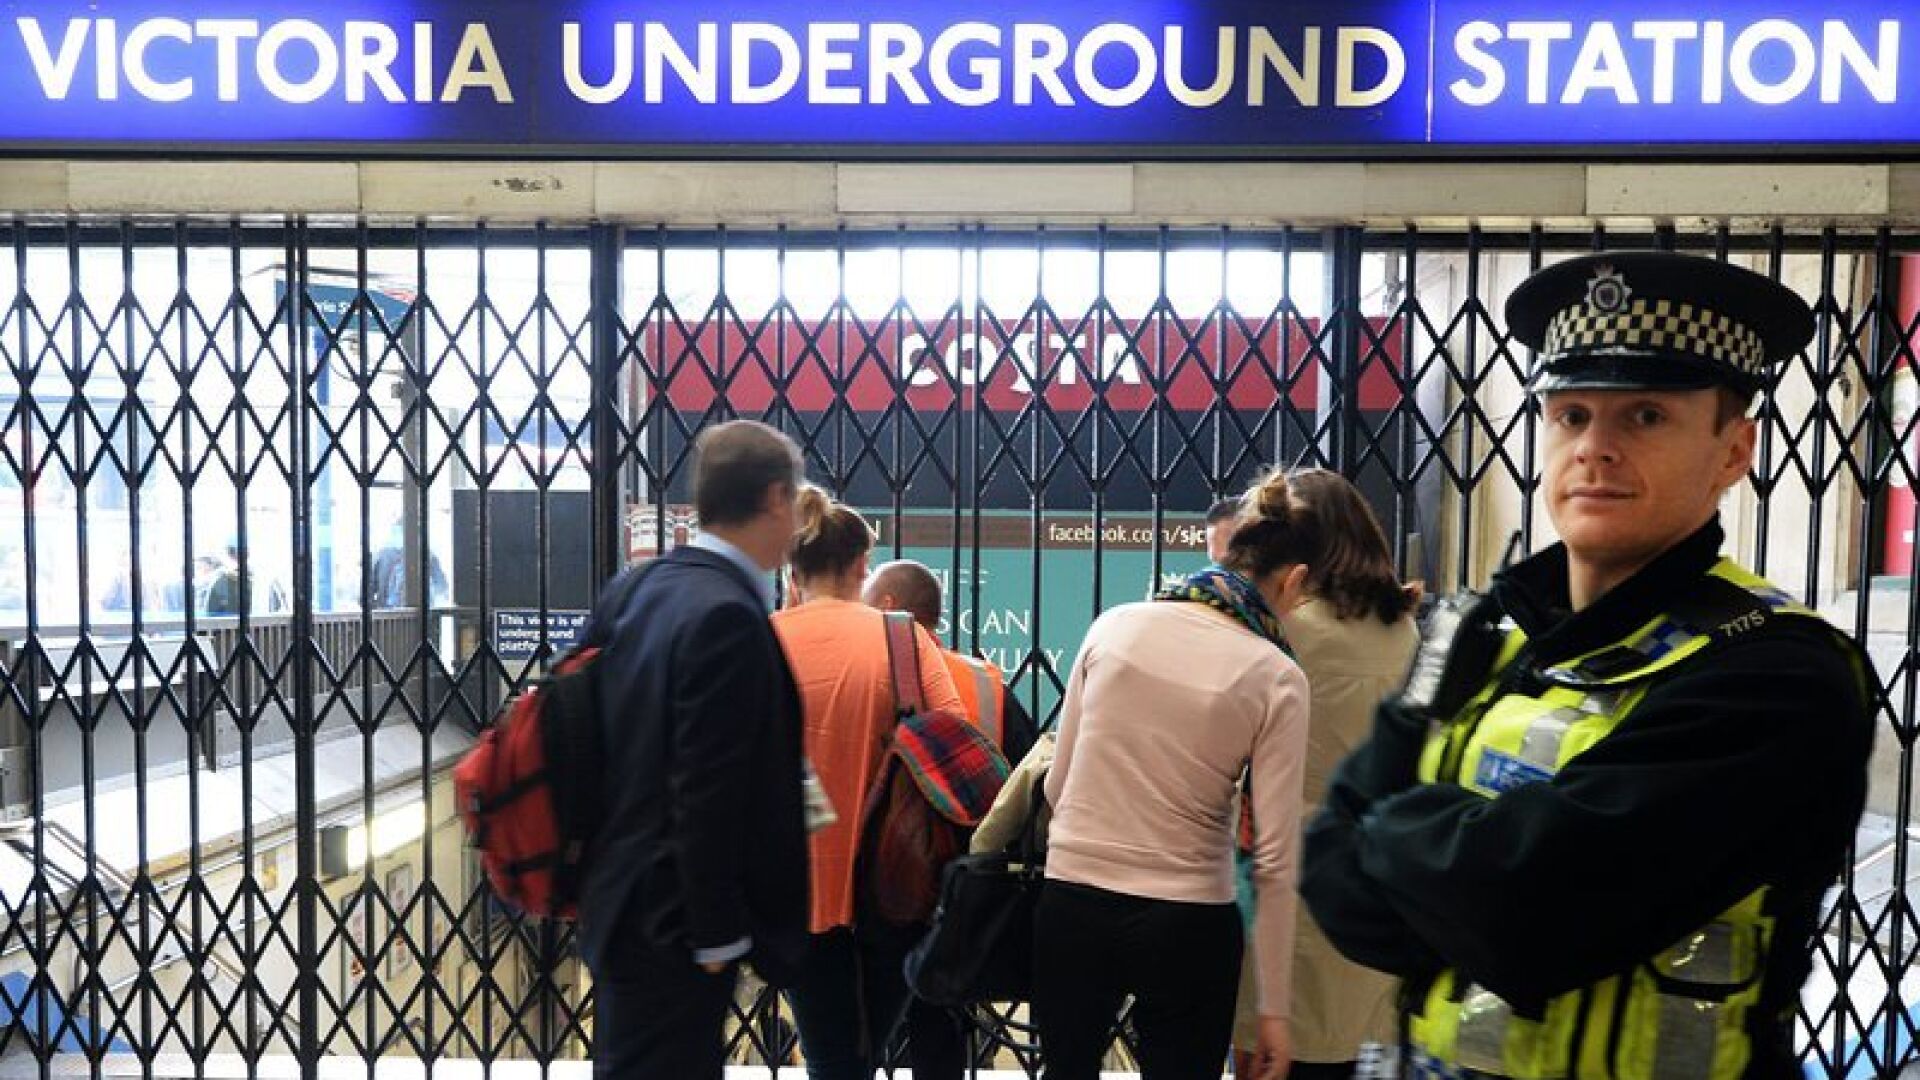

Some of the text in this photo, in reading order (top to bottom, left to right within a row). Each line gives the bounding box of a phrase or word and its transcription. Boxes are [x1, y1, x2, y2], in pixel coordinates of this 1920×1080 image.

[16, 16, 1900, 109] VICTORIA UNDERGROUND STATION
[498, 628, 575, 641] undergound
[498, 640, 558, 654] platfos
